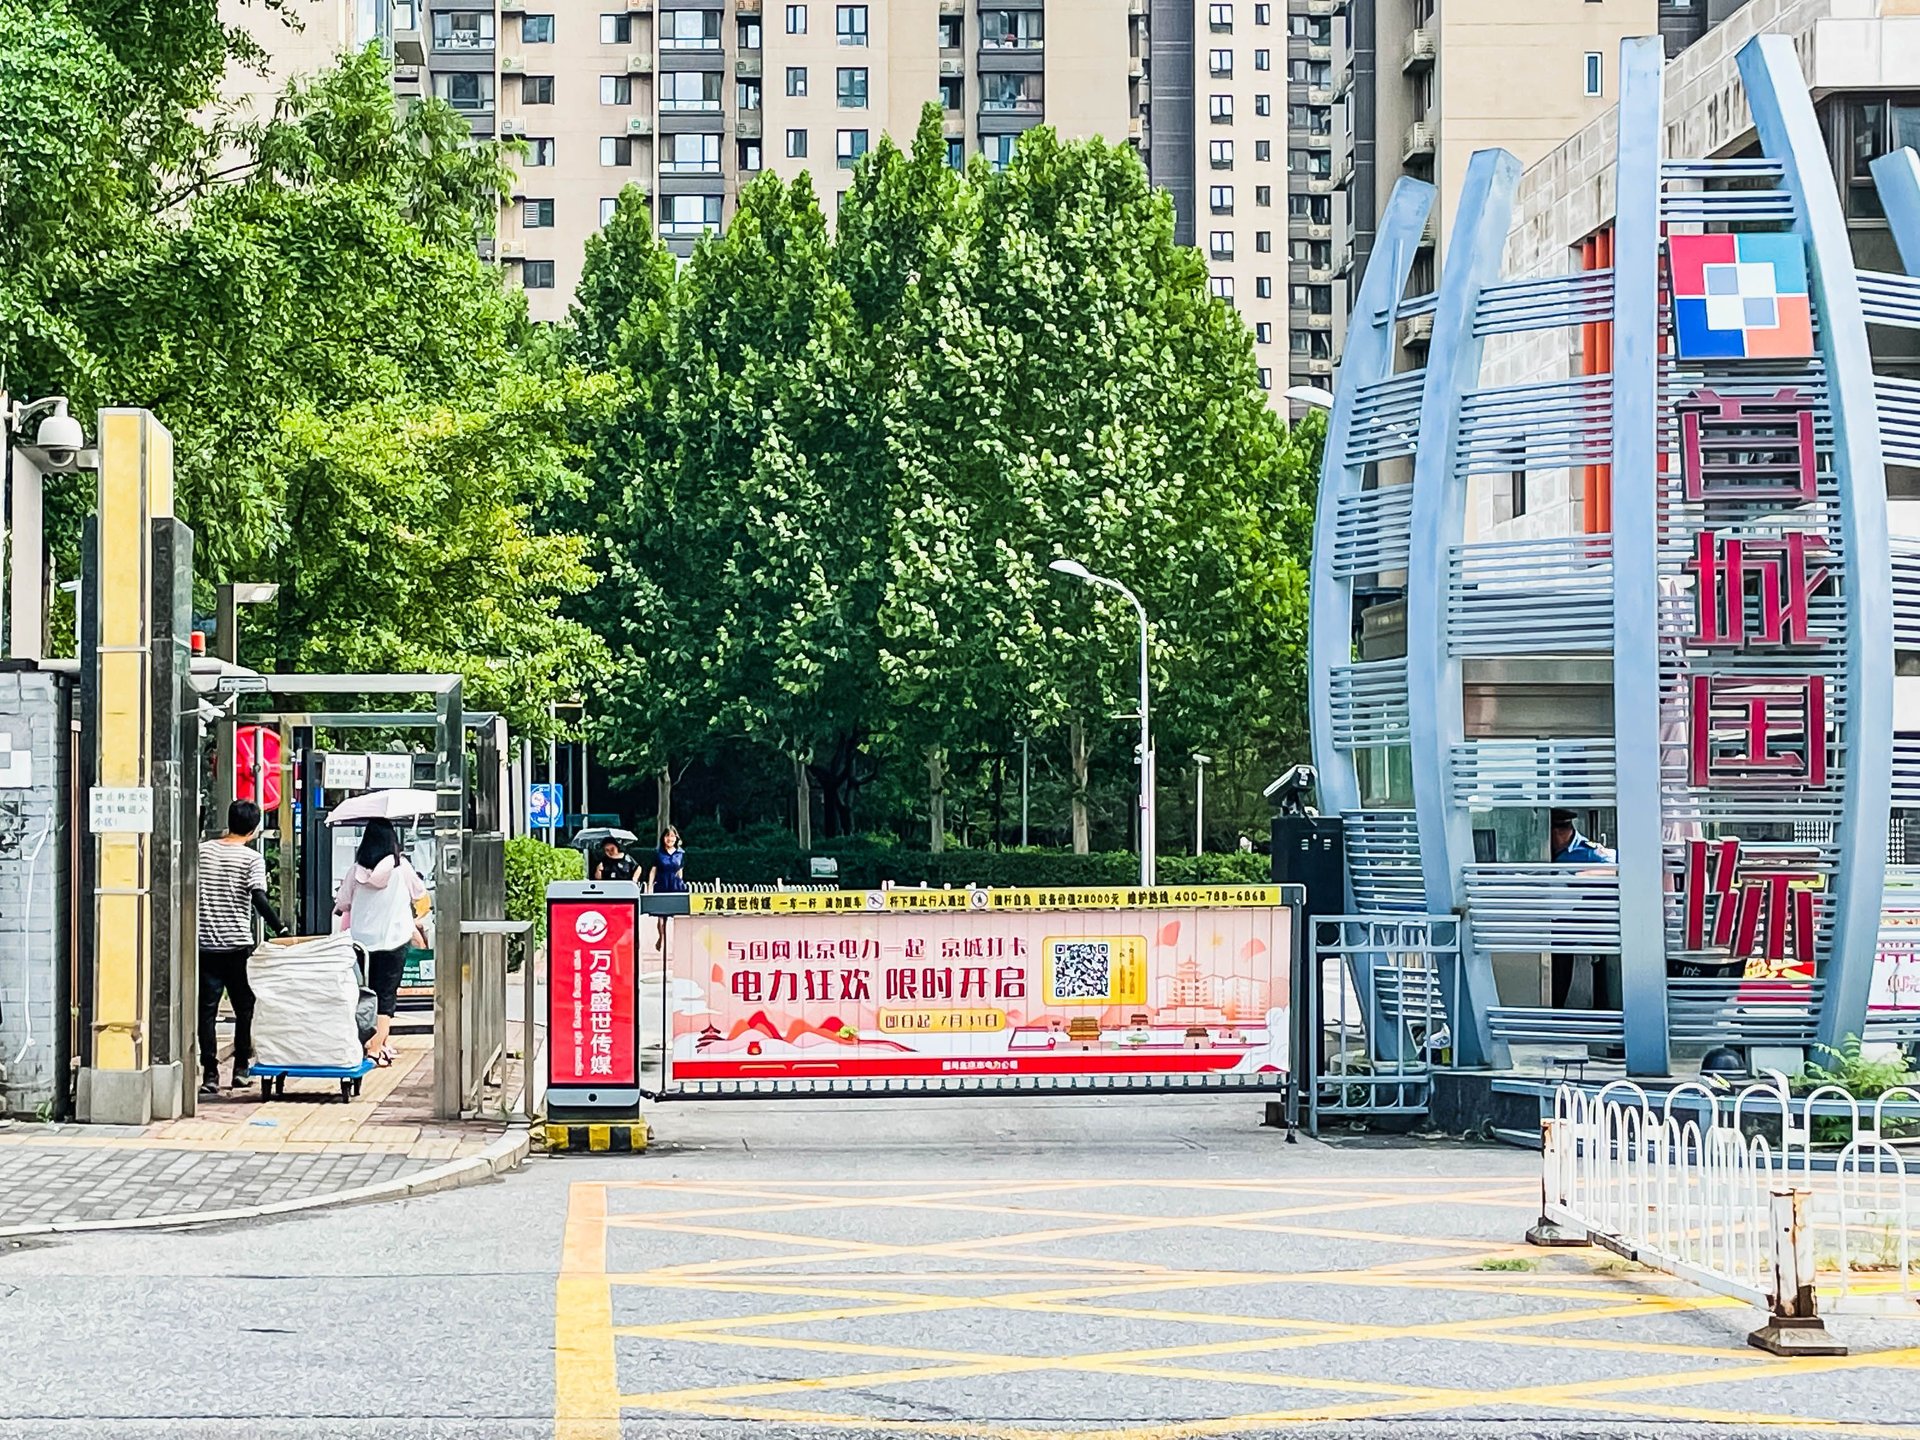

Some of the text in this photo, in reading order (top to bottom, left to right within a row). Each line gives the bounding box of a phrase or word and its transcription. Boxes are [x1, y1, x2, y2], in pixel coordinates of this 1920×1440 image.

[1675, 387, 1829, 961] 首城国际
[703, 897, 772, 911] 万象盛世传媒
[728, 937, 1028, 961] 与国网北京电力一起 京城打卡
[731, 966, 1025, 1002] 电力狂欢 限时开启
[589, 949, 613, 1075] 万象盛世传媒
